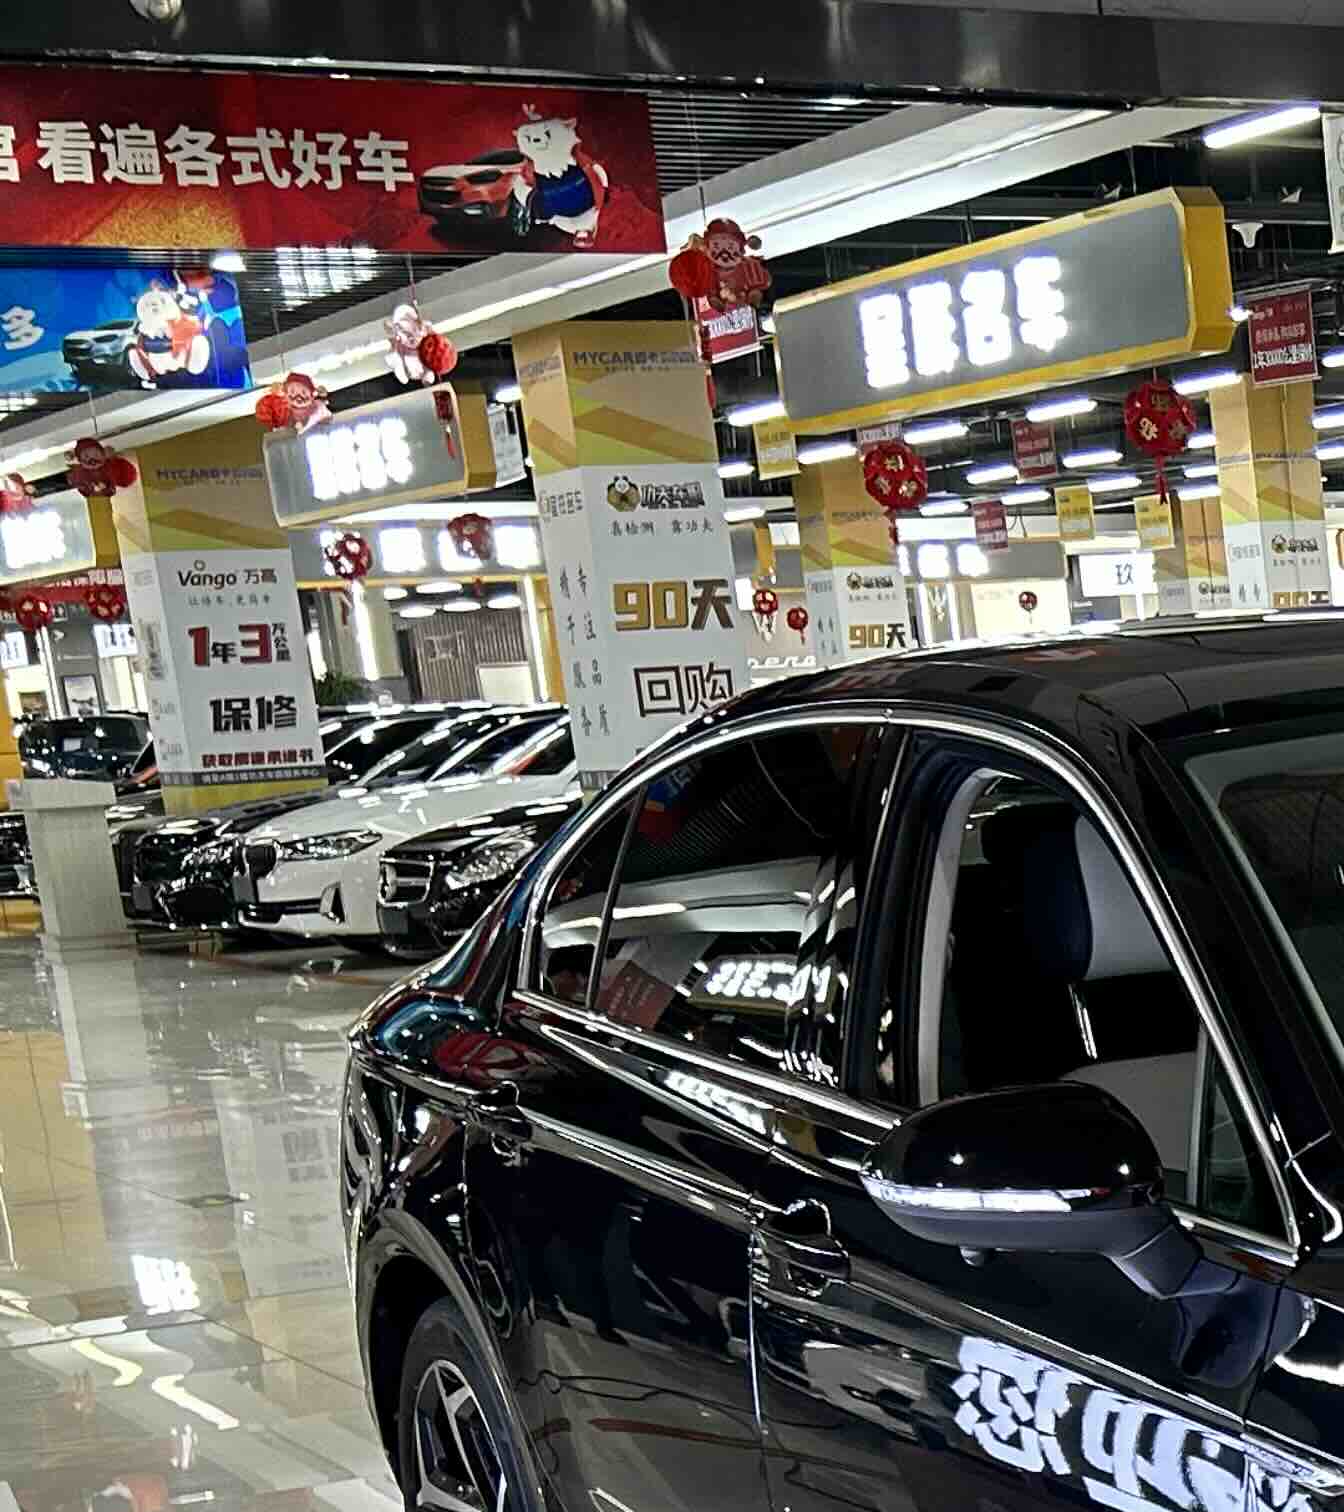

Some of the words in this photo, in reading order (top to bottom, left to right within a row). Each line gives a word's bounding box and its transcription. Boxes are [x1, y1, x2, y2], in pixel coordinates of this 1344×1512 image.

[36, 120, 414, 192] 看遍各式好车
[177, 569, 238, 590] Vango
[613, 578, 736, 632] 90天
[848, 623, 907, 649] 90天
[633, 662, 736, 718] 回购
[208, 695, 298, 734] 保修
